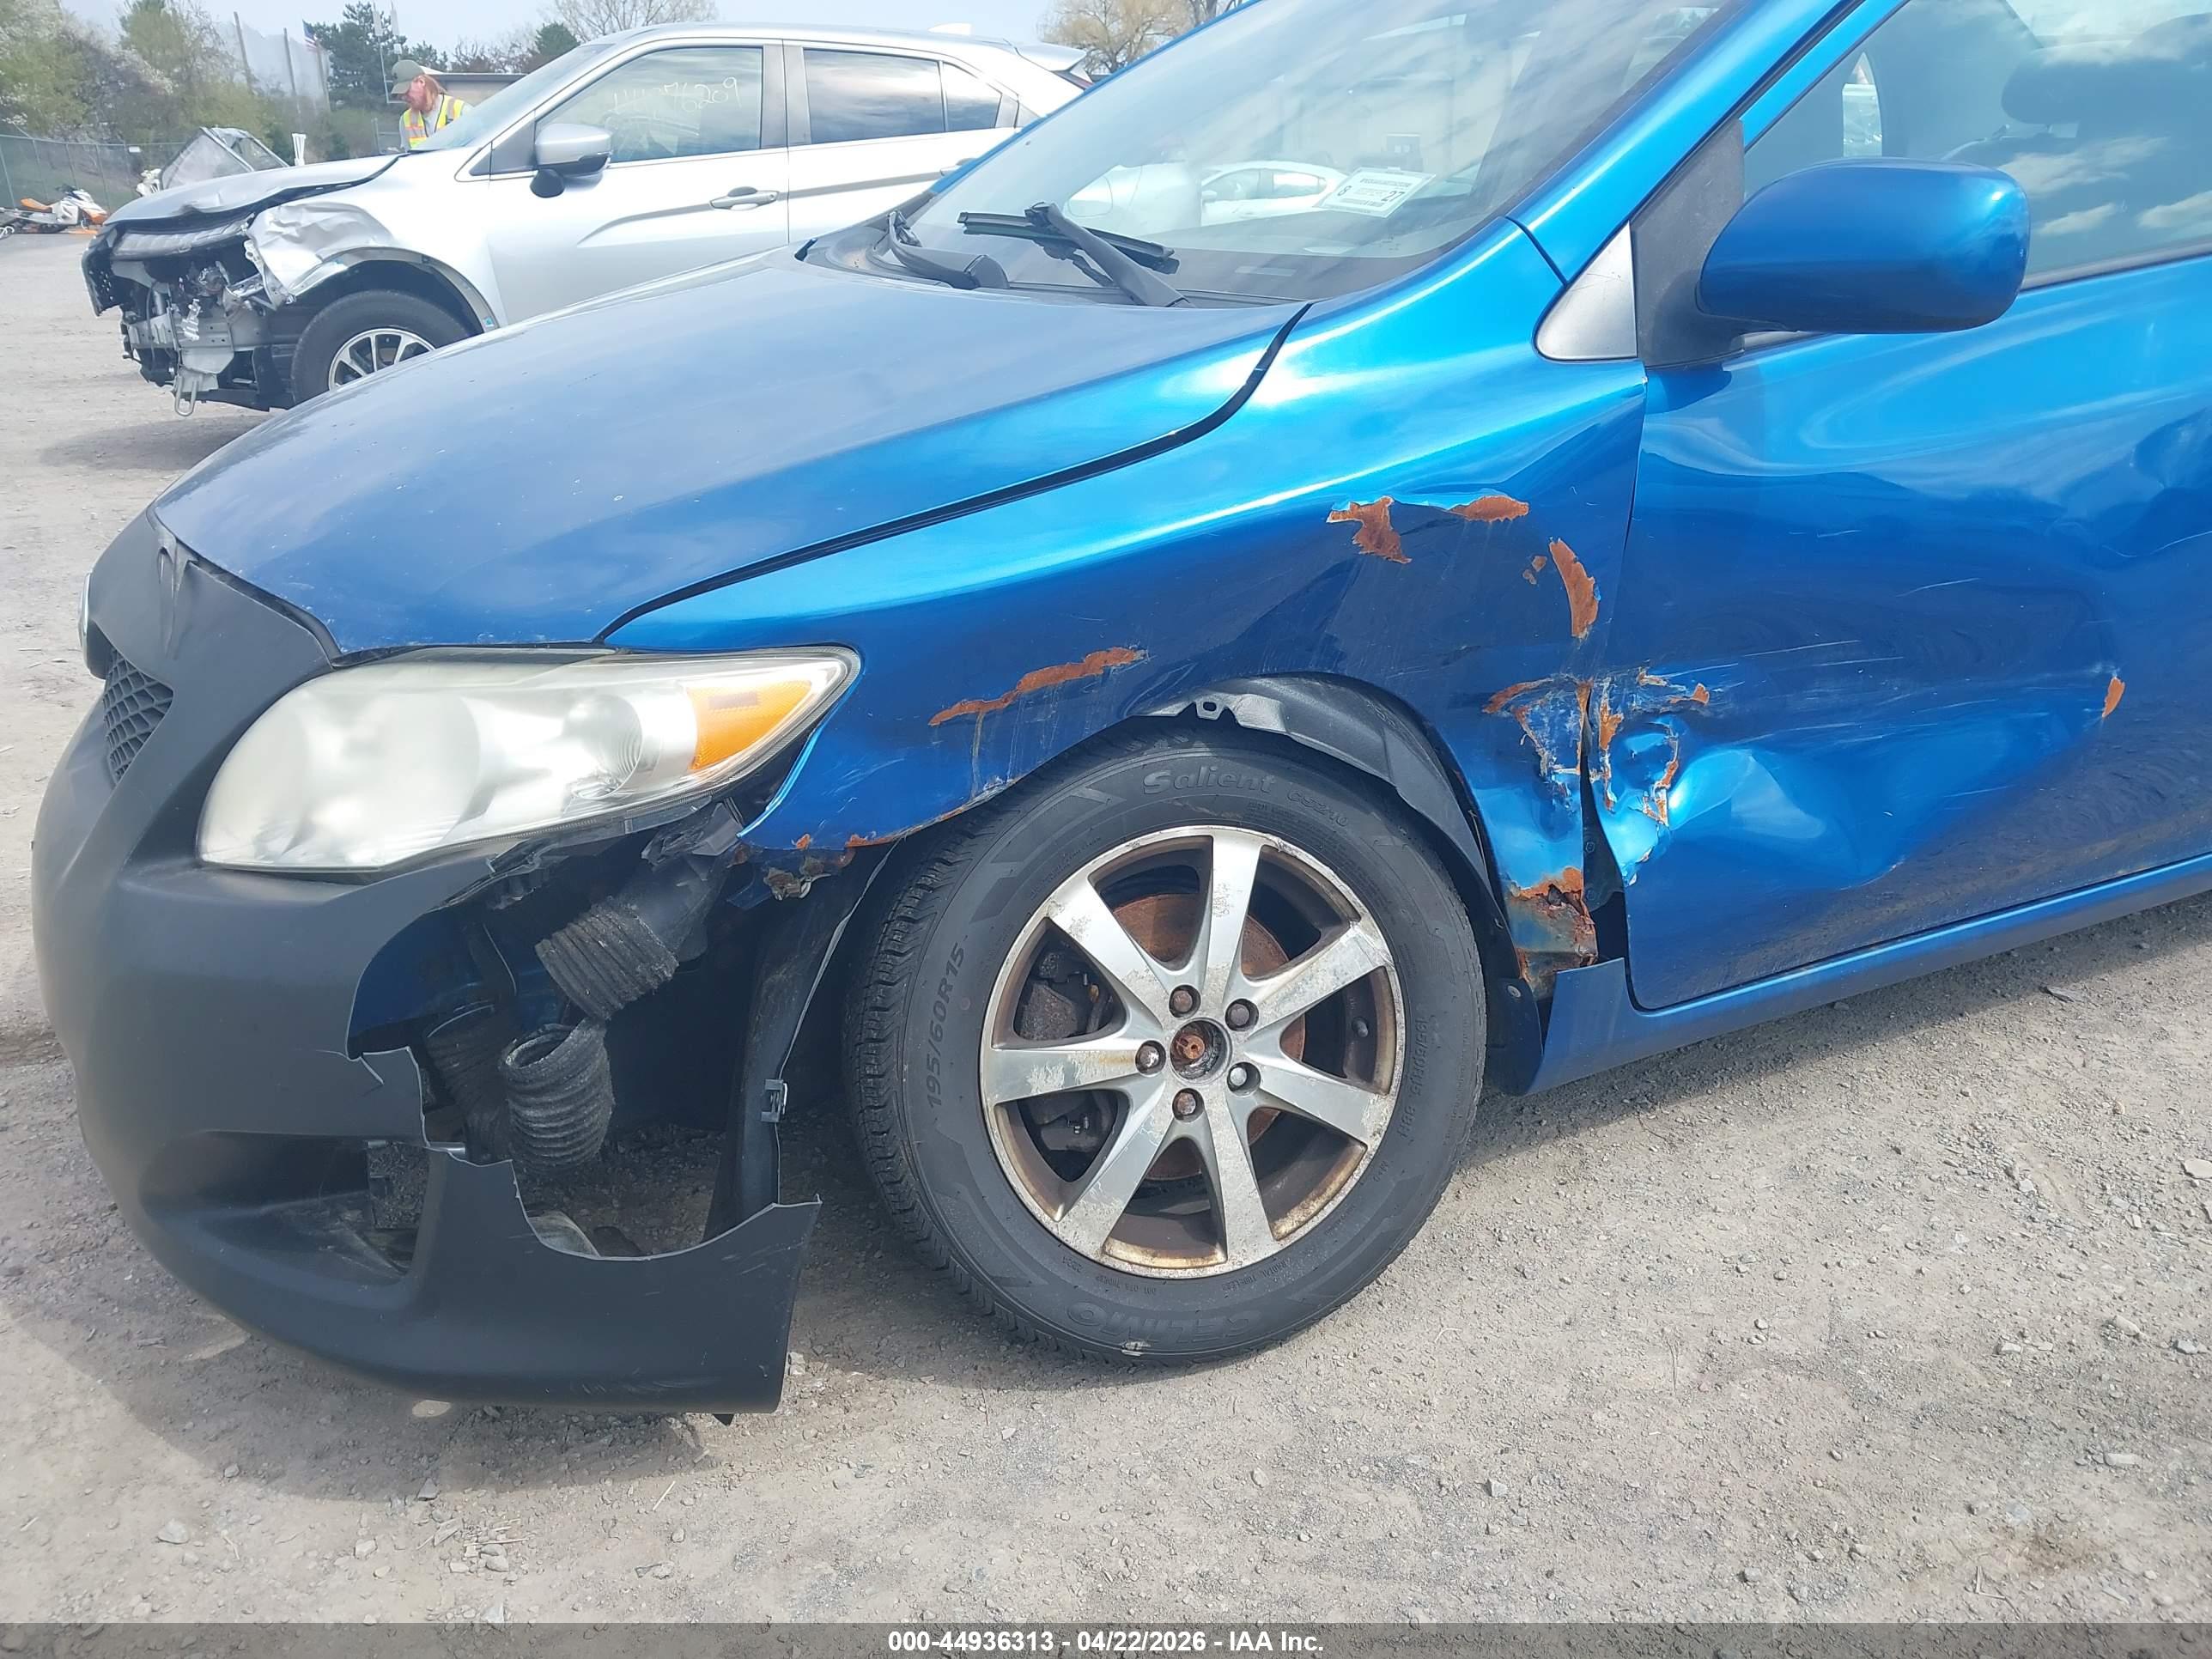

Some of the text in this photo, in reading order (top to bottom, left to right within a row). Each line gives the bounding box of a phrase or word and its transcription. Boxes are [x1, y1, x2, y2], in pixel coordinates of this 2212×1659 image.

[1380, 190, 1406, 203] 27
[1142, 763, 1278, 795] Salient
[925, 942, 965, 1109] 195/60R15
